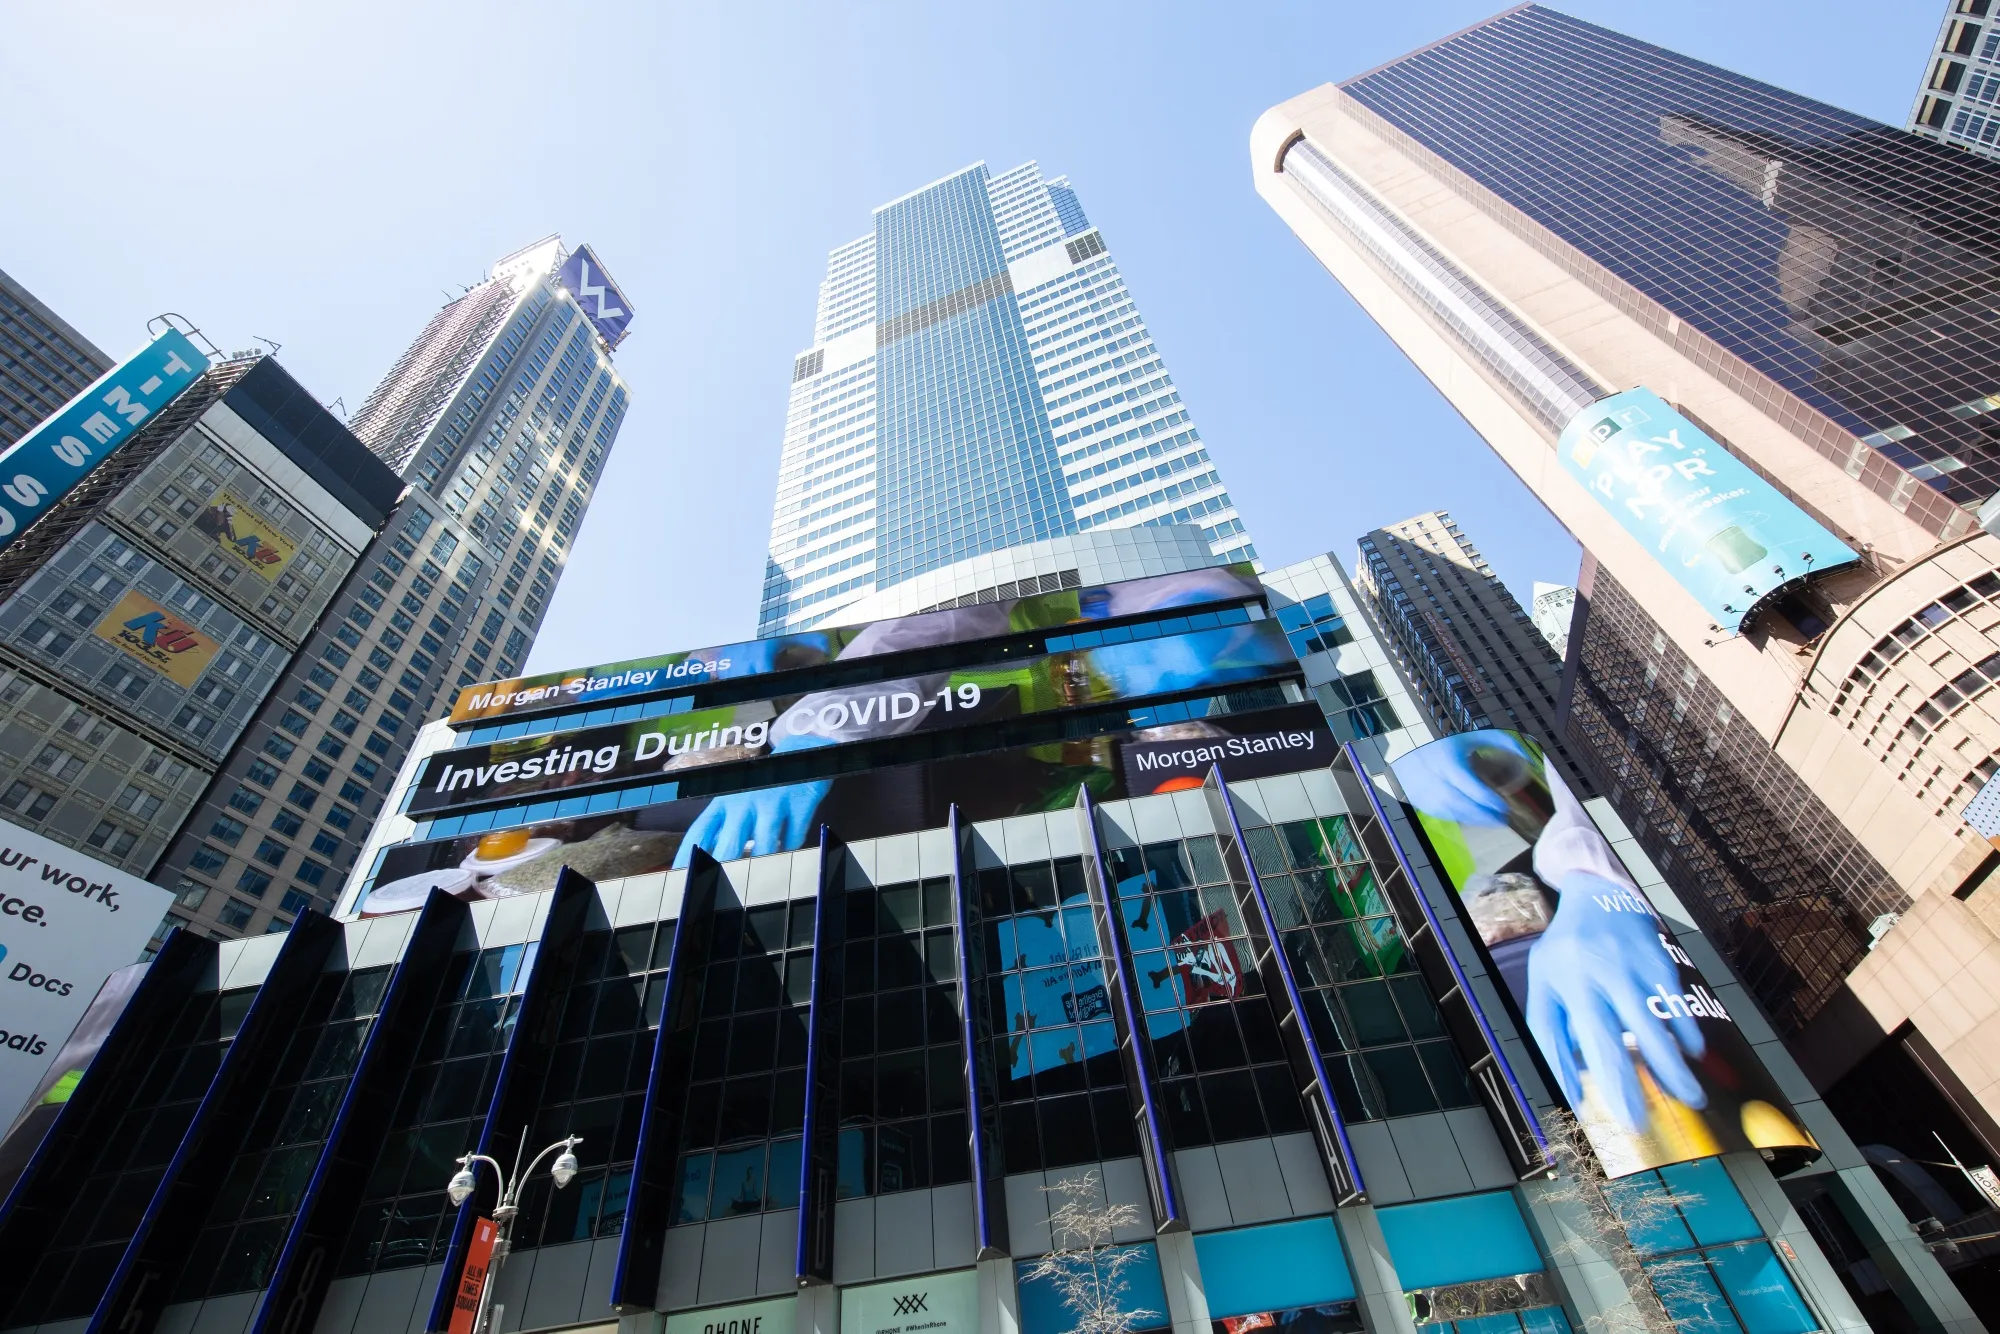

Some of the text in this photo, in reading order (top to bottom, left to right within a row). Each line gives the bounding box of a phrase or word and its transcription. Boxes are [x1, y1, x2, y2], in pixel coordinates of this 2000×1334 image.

[468, 656, 732, 711] Morgan Stanley Ideas
[435, 682, 981, 793] Investing During COVID-19
[1136, 730, 1315, 771] Morgan Stanley
[41, 863, 120, 912] work,
[1592, 889, 1653, 915] with
[0, 892, 47, 927] ce.
[8, 962, 74, 997] Docs
[456, 1295, 477, 1313] SQUARE
[463, 1280, 479, 1297] TIMES
